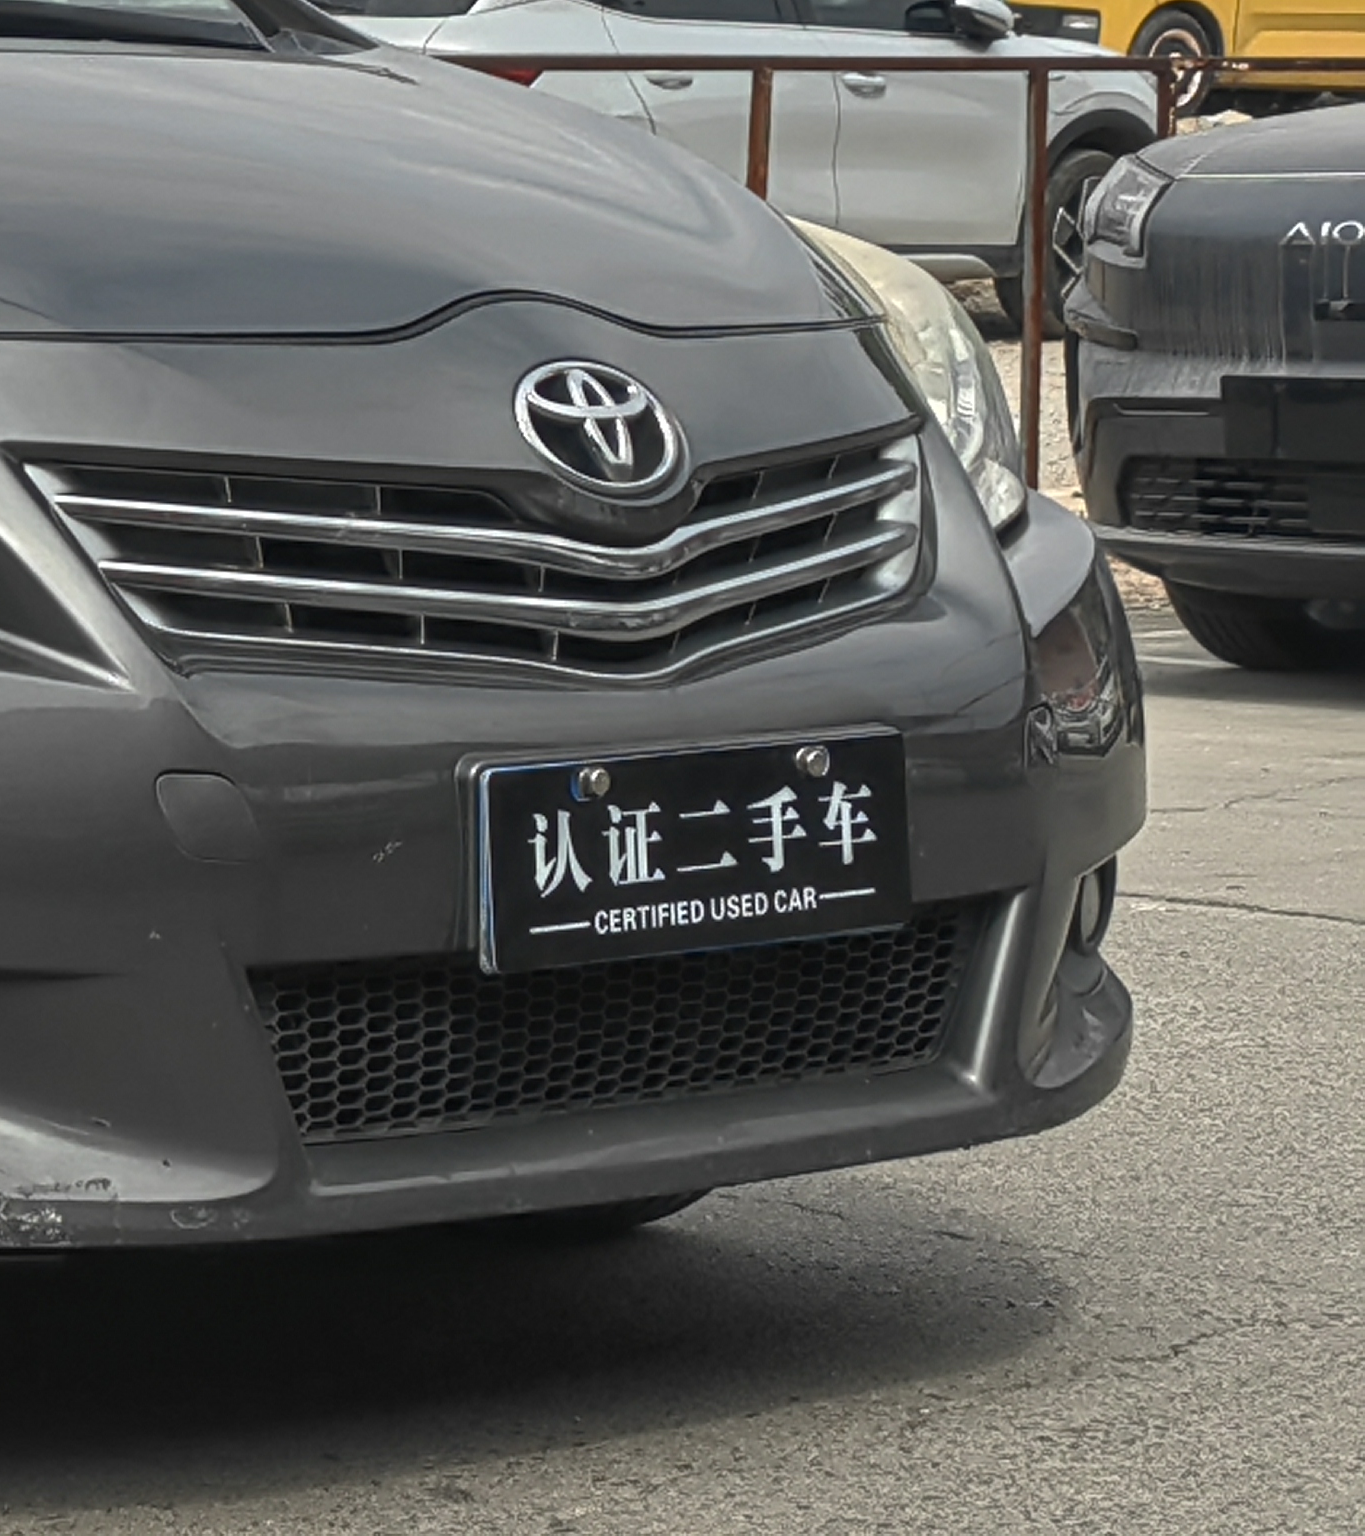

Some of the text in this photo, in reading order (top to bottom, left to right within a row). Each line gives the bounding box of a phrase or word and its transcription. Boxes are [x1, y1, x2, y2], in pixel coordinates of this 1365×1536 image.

[528, 781, 877, 898] 认证二手车
[594, 885, 818, 935] CERTIFIED USED CAR
